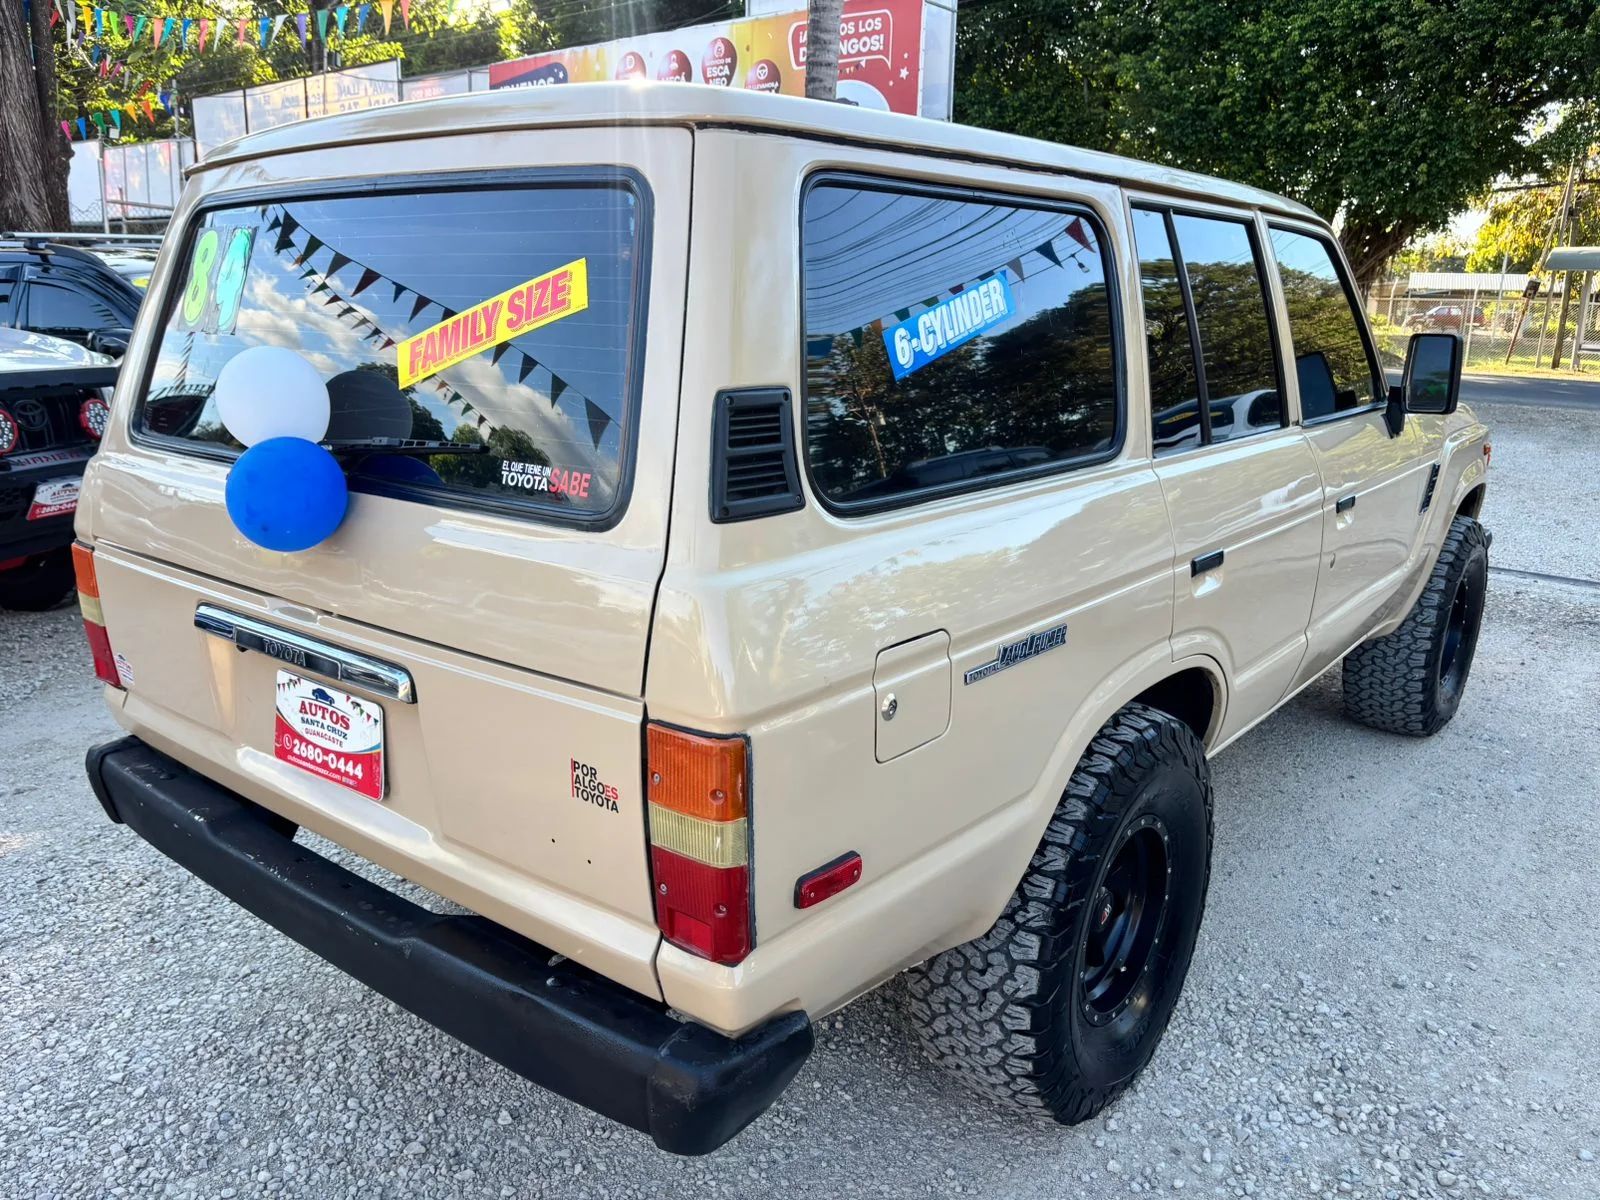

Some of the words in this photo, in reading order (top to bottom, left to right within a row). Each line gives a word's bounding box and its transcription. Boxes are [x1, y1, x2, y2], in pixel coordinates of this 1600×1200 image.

[859, 17, 882, 33] LOS
[707, 65, 730, 77] ESCA
[409, 300, 504, 378] FAMILY
[506, 269, 573, 333] SIZE
[894, 278, 1009, 369] 6-CYLINDER
[501, 470, 548, 492] TOYOTA
[549, 467, 591, 498] SABE
[502, 460, 510, 471] EL
[510, 462, 524, 473] QUE
[525, 463, 542, 475] TIENE
[542, 466, 552, 477] UN
[263, 638, 306, 667] TOYOTA
[299, 700, 350, 731] AUTOS
[300, 716, 325, 731] SANTA
[327, 725, 348, 740] CRUZ
[305, 727, 343, 748] GUANACASTE
[293, 738, 363, 779] 2680-0444
[573, 760, 597, 780] POR
[574, 786, 619, 814] TOYOTA
